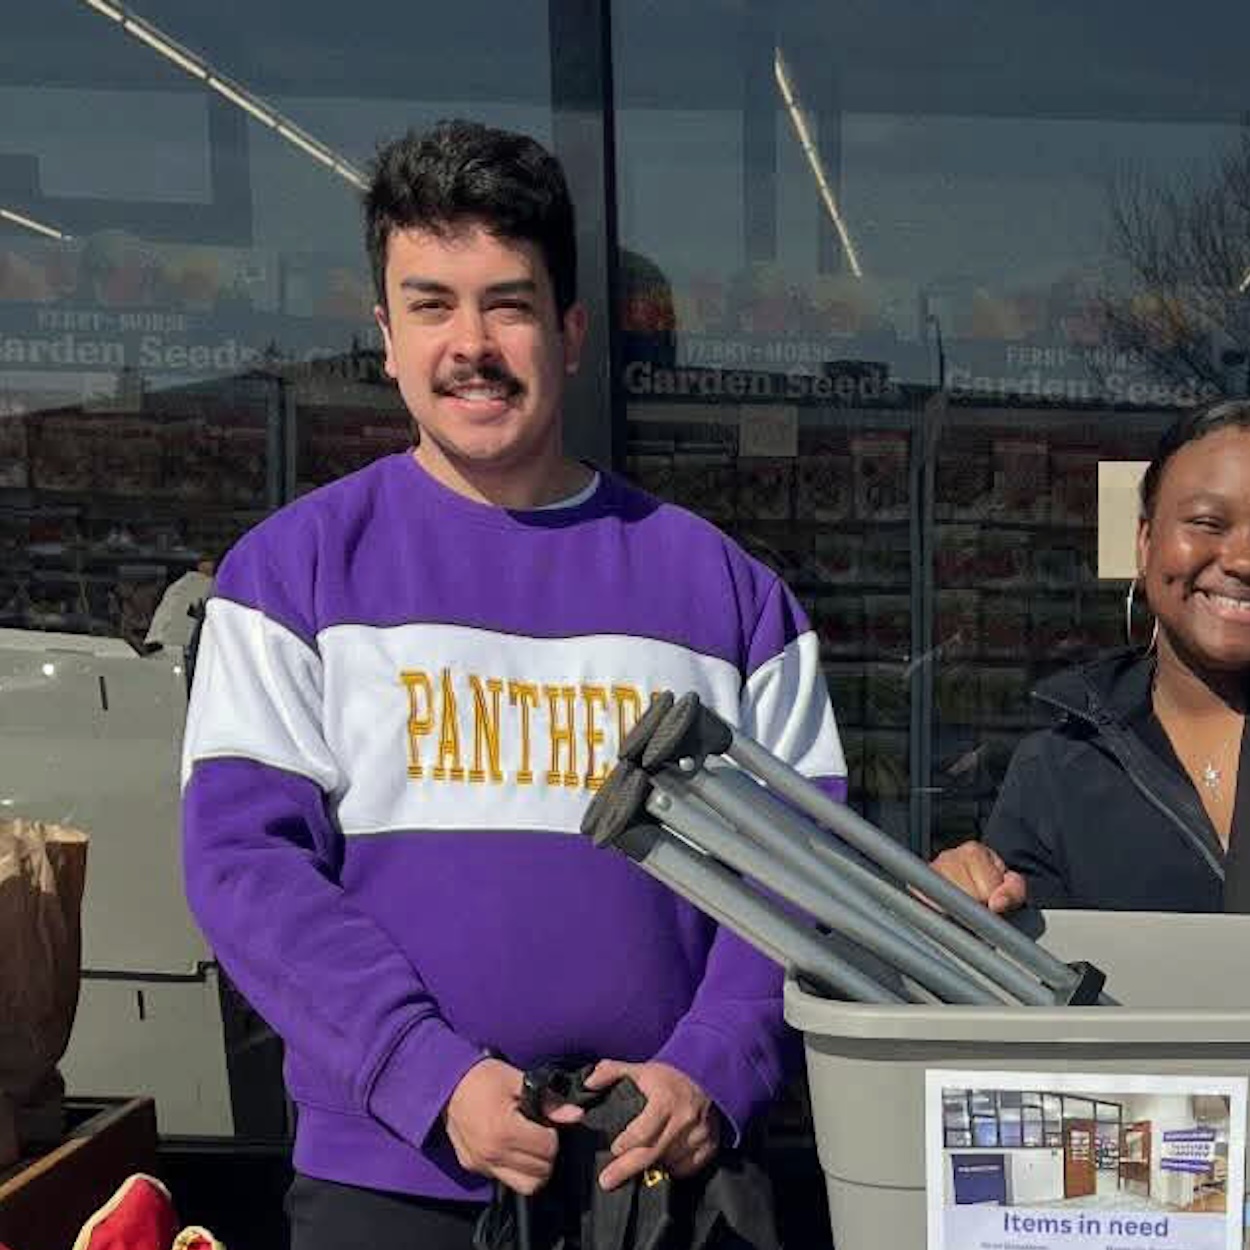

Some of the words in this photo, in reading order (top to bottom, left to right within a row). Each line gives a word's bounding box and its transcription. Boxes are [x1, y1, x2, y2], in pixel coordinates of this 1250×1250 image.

[0, 332, 124, 365] arden
[625, 360, 772, 396] Garden
[399, 667, 664, 792] PANTHER
[1003, 1211, 1072, 1232] Items
[1078, 1213, 1101, 1234] in
[1109, 1215, 1169, 1237] need
